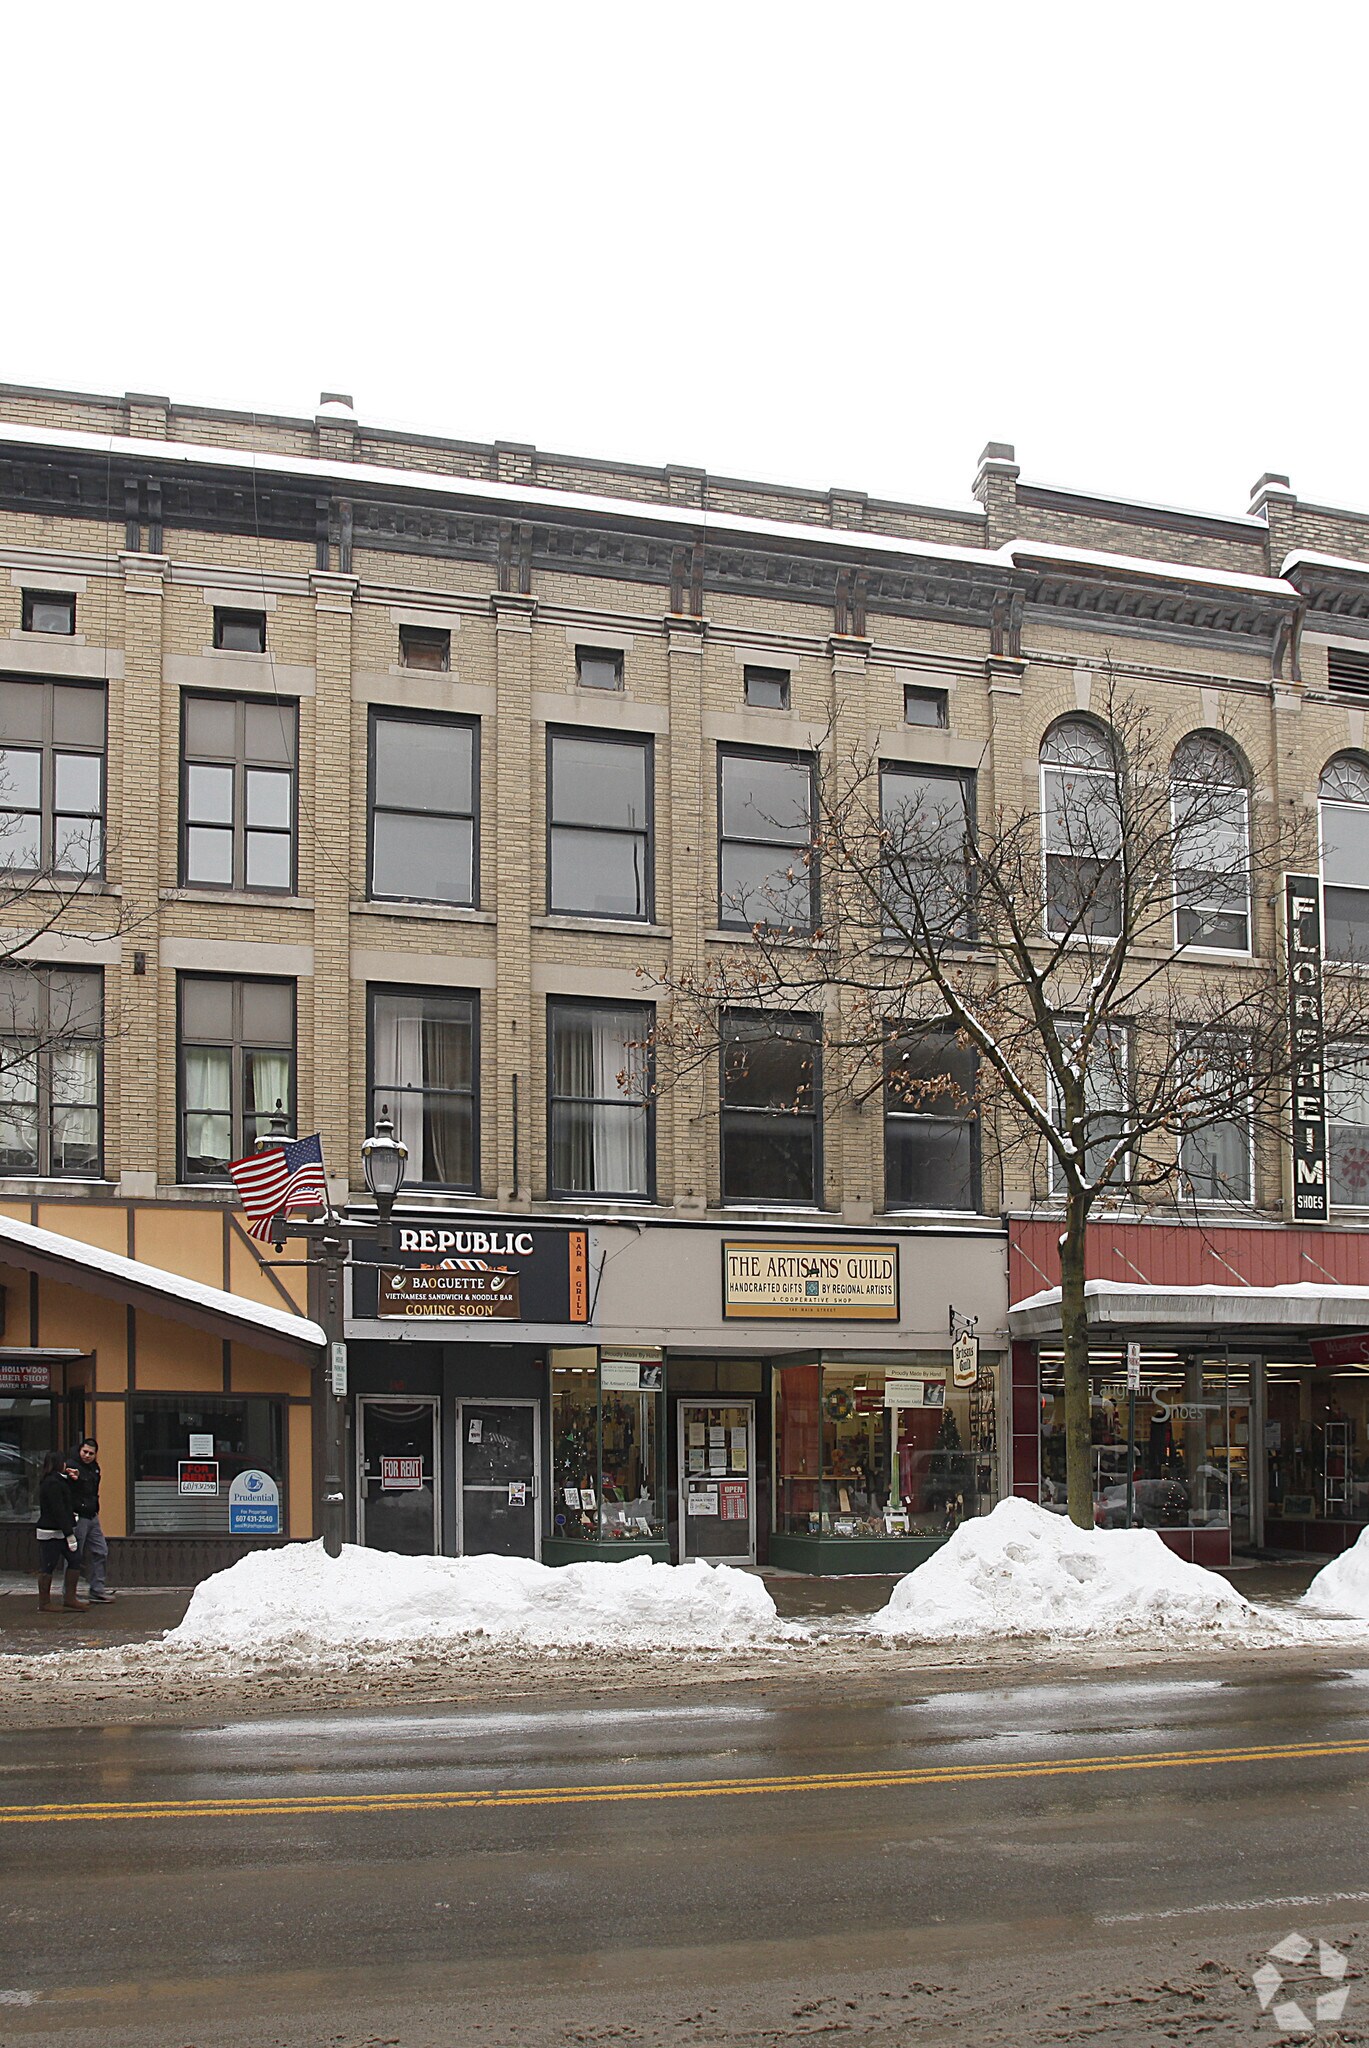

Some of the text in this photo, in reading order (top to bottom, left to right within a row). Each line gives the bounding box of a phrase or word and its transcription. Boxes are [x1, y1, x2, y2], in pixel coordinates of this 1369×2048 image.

[1298, 1195, 1324, 1209] SHOES
[399, 1229, 534, 1255] REPUBLIC
[576, 1265, 582, 1273] &
[728, 1256, 893, 1280] THE ARTISANS' GUILD
[412, 1277, 485, 1289] BAOGUETTE
[729, 1282, 893, 1295] HANDCRAFTED GIFTS BY REGIONAL ARTISTS
[385, 1292, 427, 1300] VIETNAMESE
[428, 1293, 464, 1301] SANDWICH
[405, 1304, 494, 1316] COMING SOON
[1, 1365, 48, 1374] HOLLYWOOD
[891, 1369, 909, 1377] Proudly
[187, 1464, 209, 1473] FOR
[384, 1460, 420, 1478] FOR RENT
[182, 1473, 216, 1482] RENT
[724, 1485, 743, 1494] OPEN
[234, 1493, 274, 1502] Prudential
[235, 1515, 273, 1523] 607 431-2540
